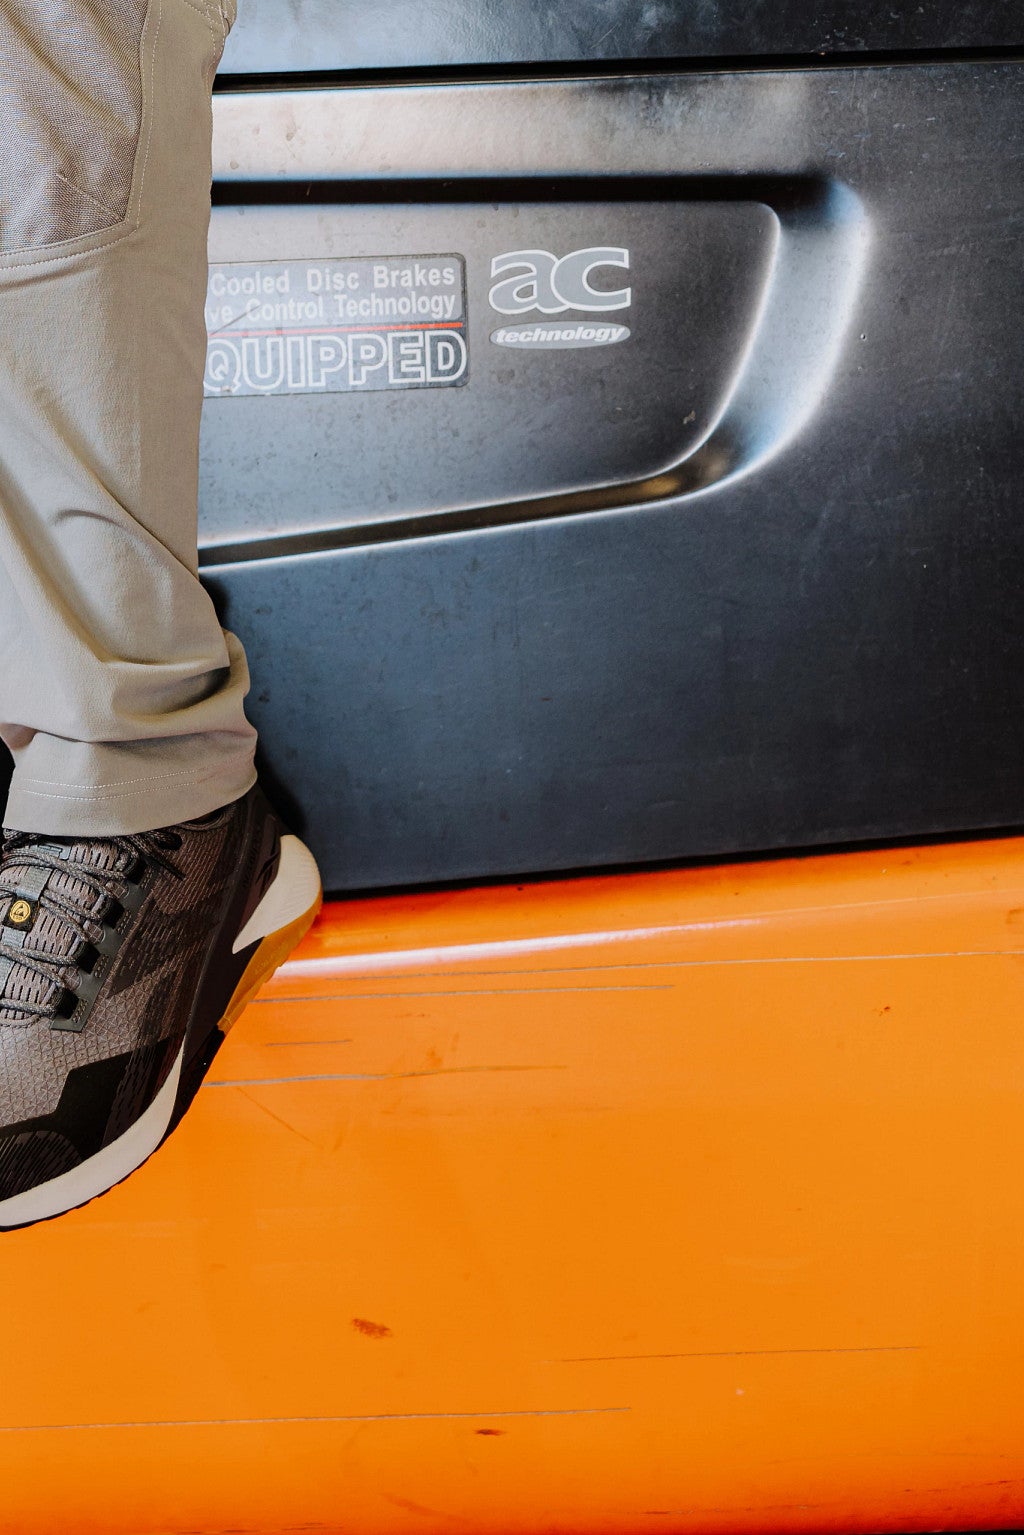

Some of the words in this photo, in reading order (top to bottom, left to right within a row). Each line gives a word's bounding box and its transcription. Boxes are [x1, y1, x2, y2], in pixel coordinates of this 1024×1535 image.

[209, 270, 290, 296] Cooled
[307, 267, 360, 292] Disc
[374, 264, 455, 289] Brakes
[489, 247, 632, 315] ac
[207, 306, 233, 324] ve
[246, 297, 324, 323] Control
[334, 292, 455, 320] Technology
[495, 326, 626, 344] technology
[203, 330, 468, 394] QUIPPED
